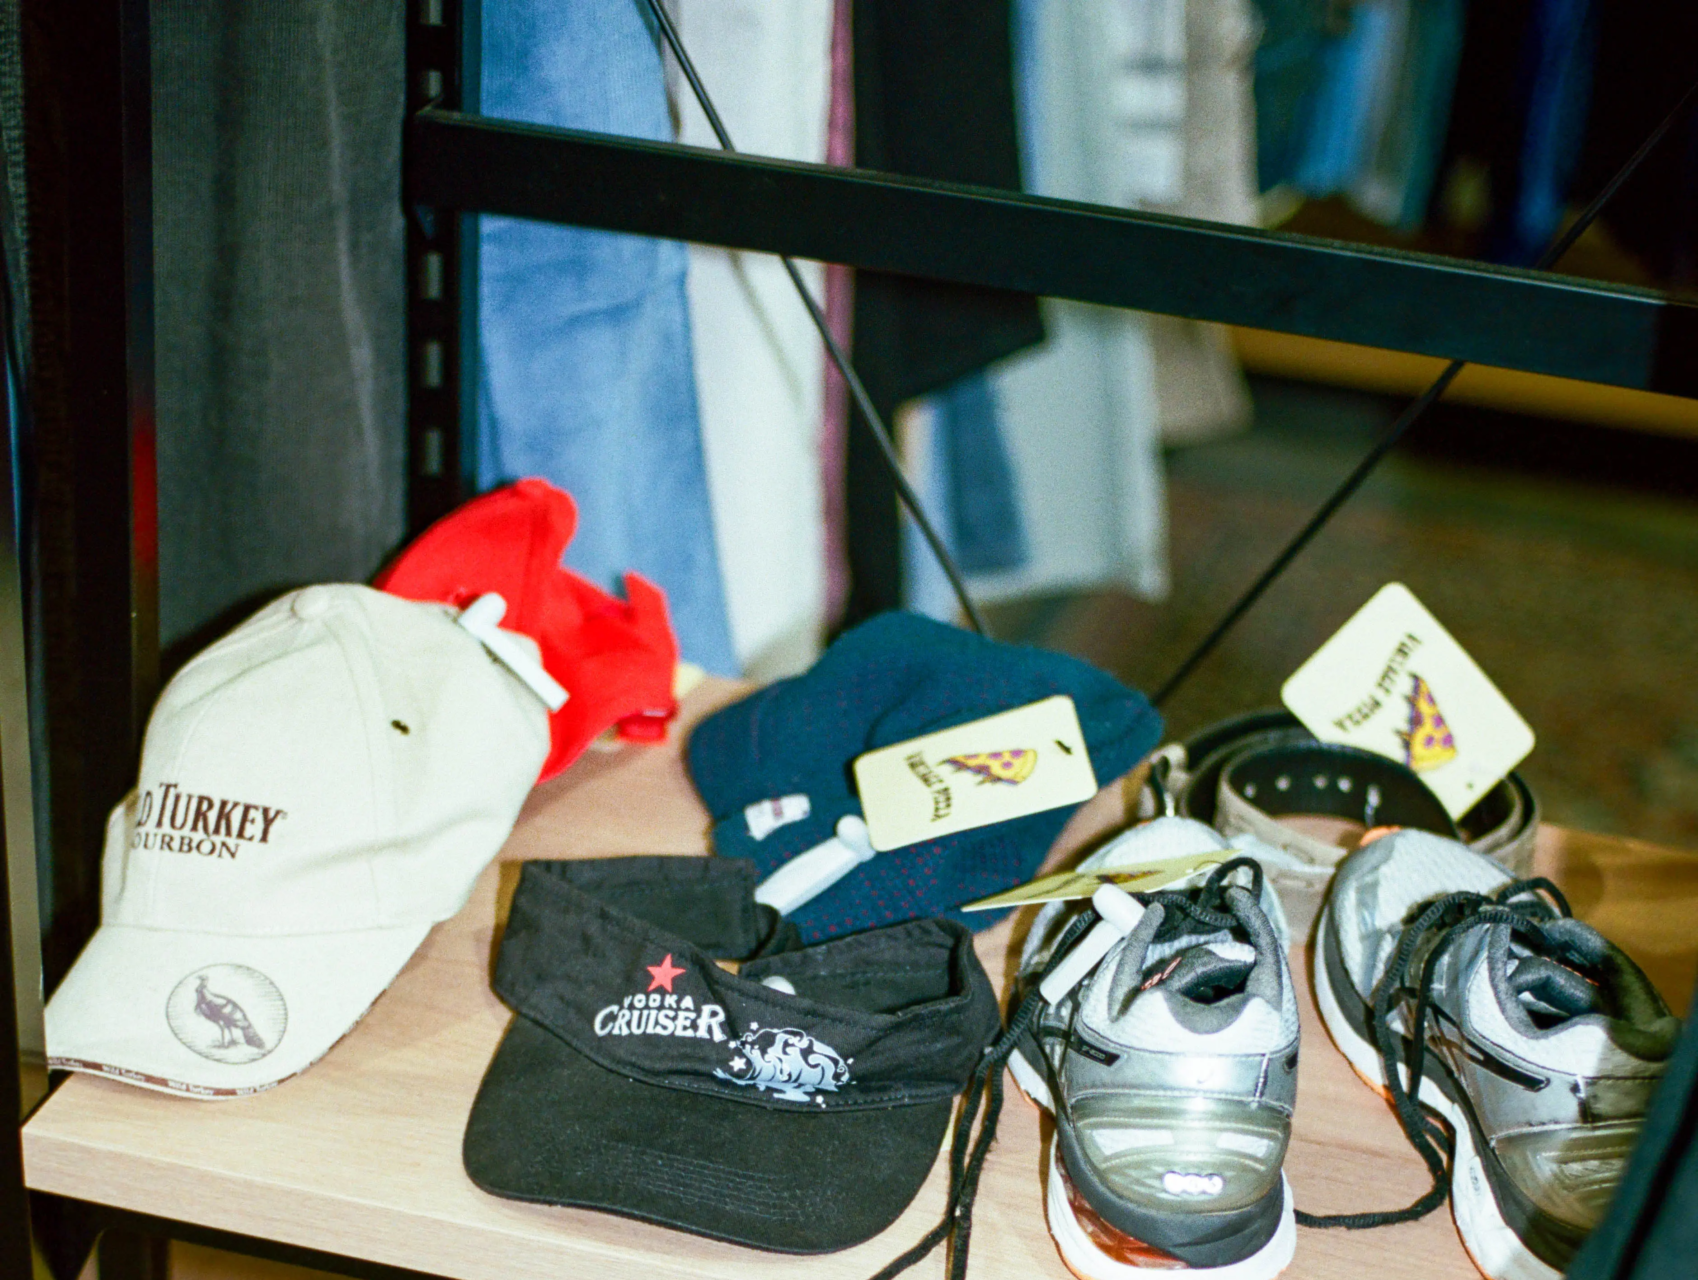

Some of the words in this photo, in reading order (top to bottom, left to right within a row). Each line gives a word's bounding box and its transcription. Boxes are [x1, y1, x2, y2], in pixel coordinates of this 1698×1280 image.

[155, 782, 284, 844] TURKEY
[131, 832, 240, 860] OURBON
[623, 993, 695, 1011] VODKA
[594, 1004, 728, 1043] CRUISER
